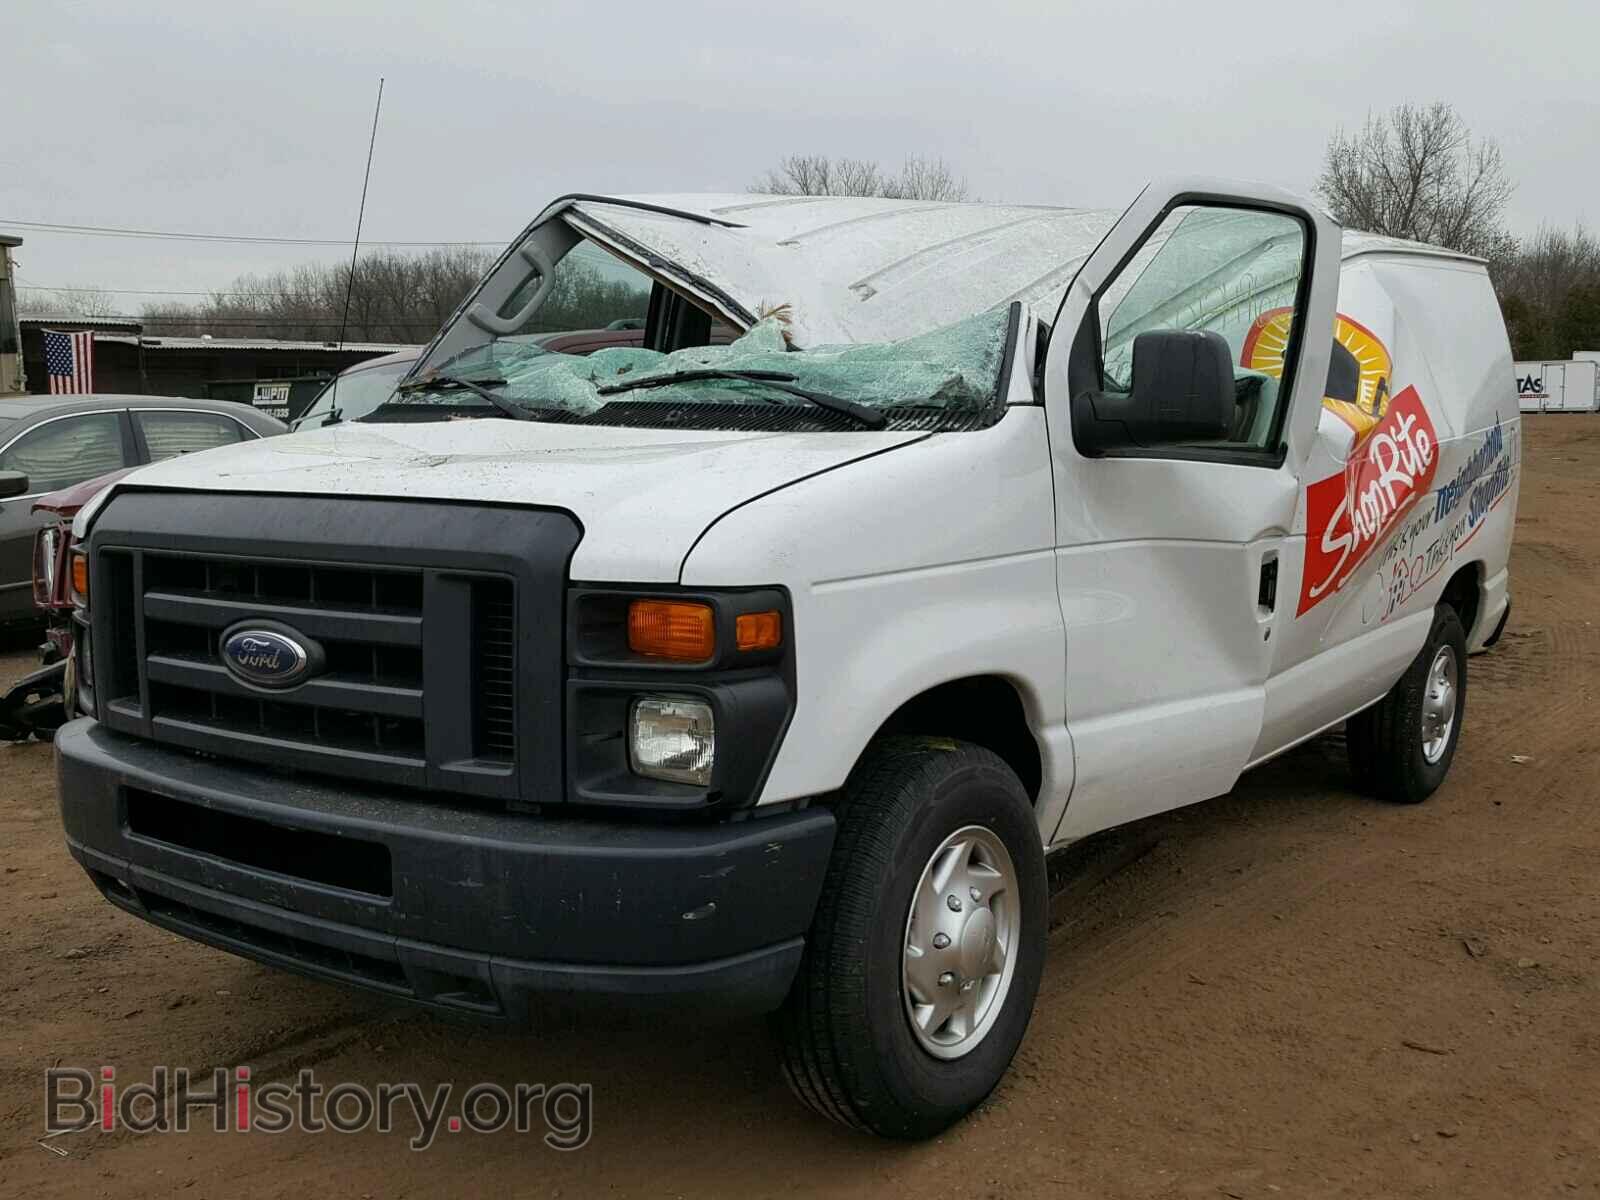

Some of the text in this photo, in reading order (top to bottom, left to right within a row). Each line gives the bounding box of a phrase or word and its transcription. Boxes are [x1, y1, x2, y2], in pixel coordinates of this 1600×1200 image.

[1309, 411, 1433, 598] ShopRite
[1410, 506, 1435, 557] your
[1434, 409, 1503, 524] neighborhood
[238, 637, 281, 669] Ford
